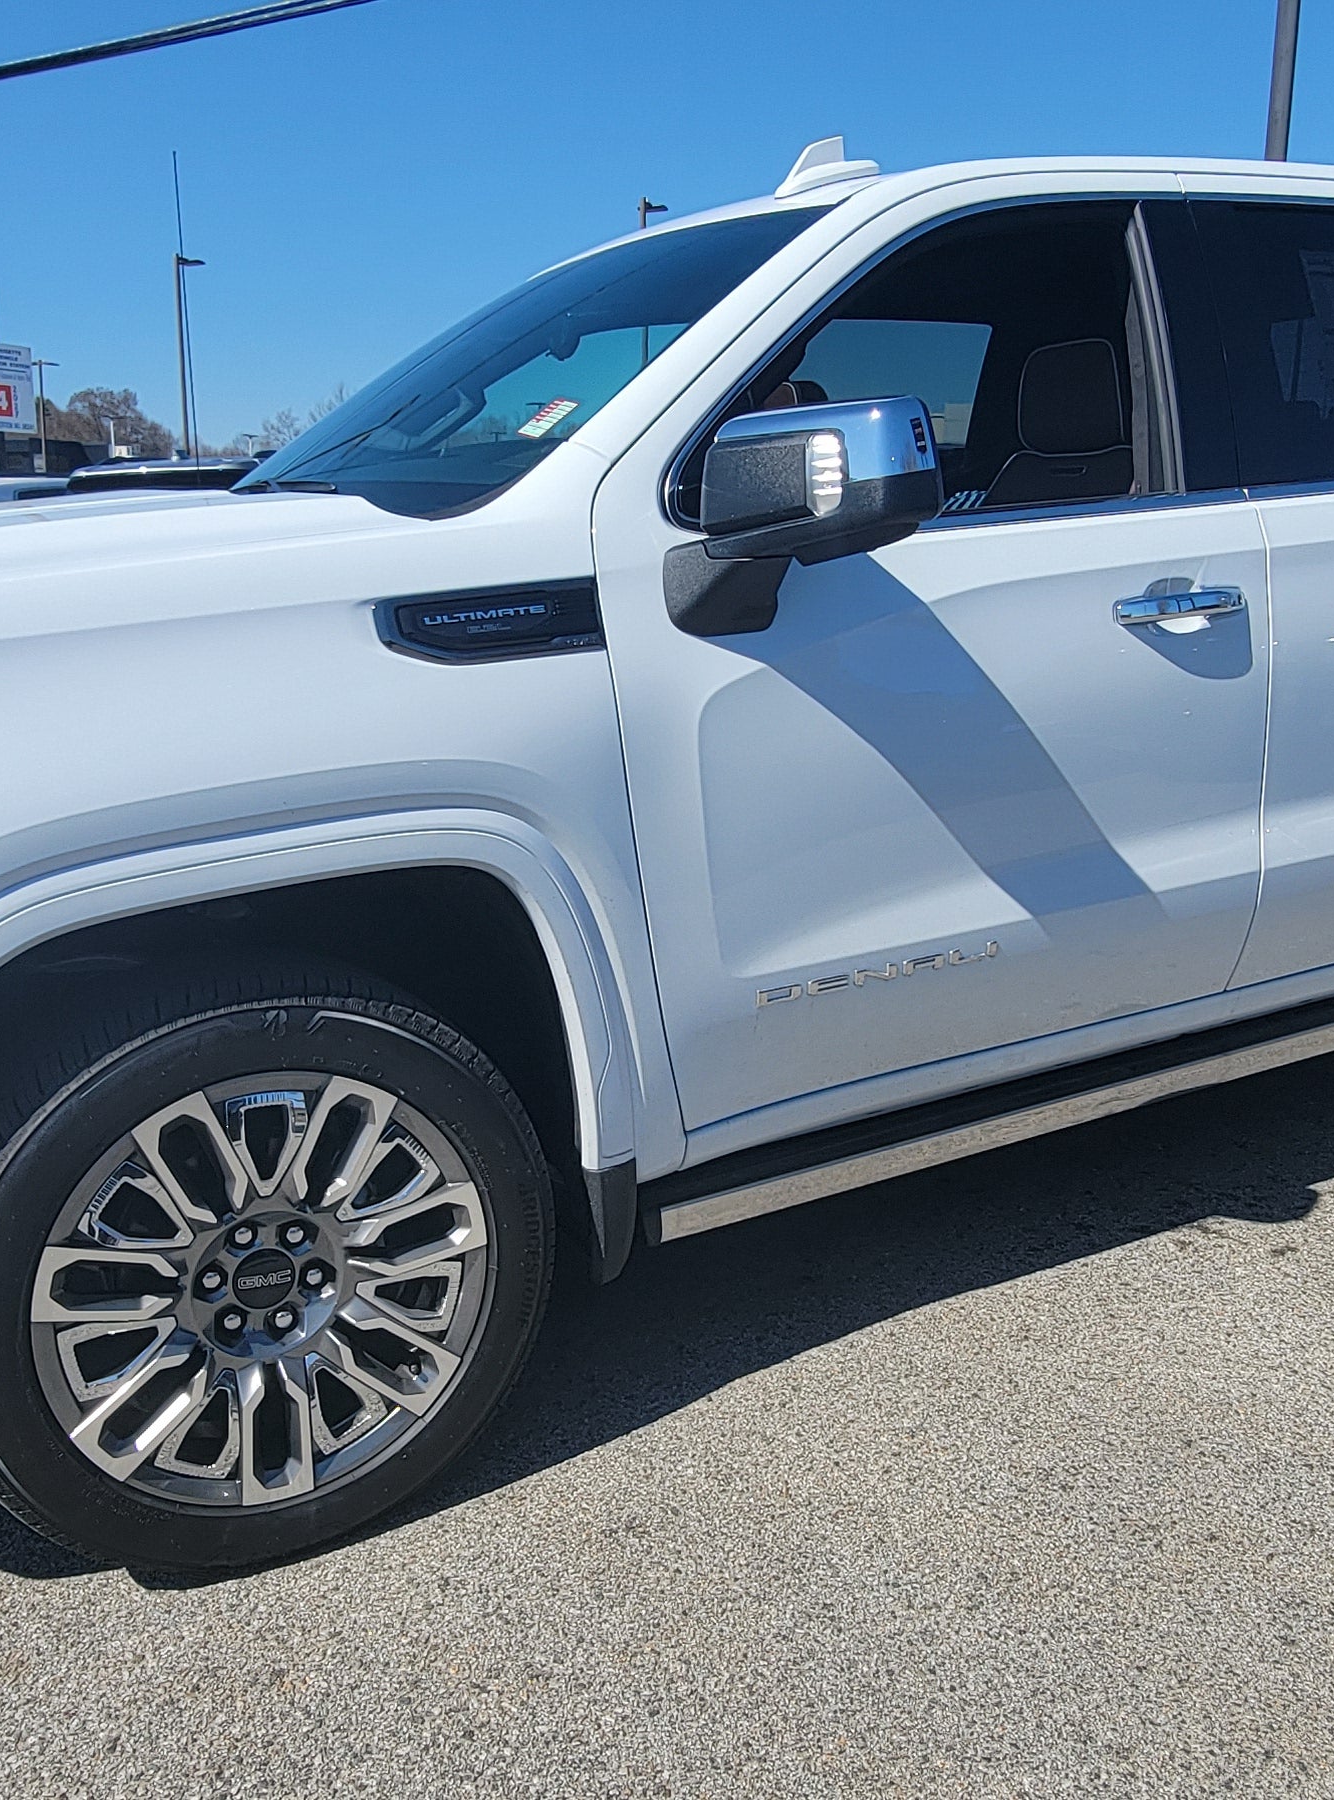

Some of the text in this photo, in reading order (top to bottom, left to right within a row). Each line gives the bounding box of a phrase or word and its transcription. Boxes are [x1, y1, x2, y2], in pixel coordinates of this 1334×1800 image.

[423, 604, 547, 627] ULTIMATE
[756, 940, 999, 1009] DENALI
[237, 1269, 292, 1290] GMC
